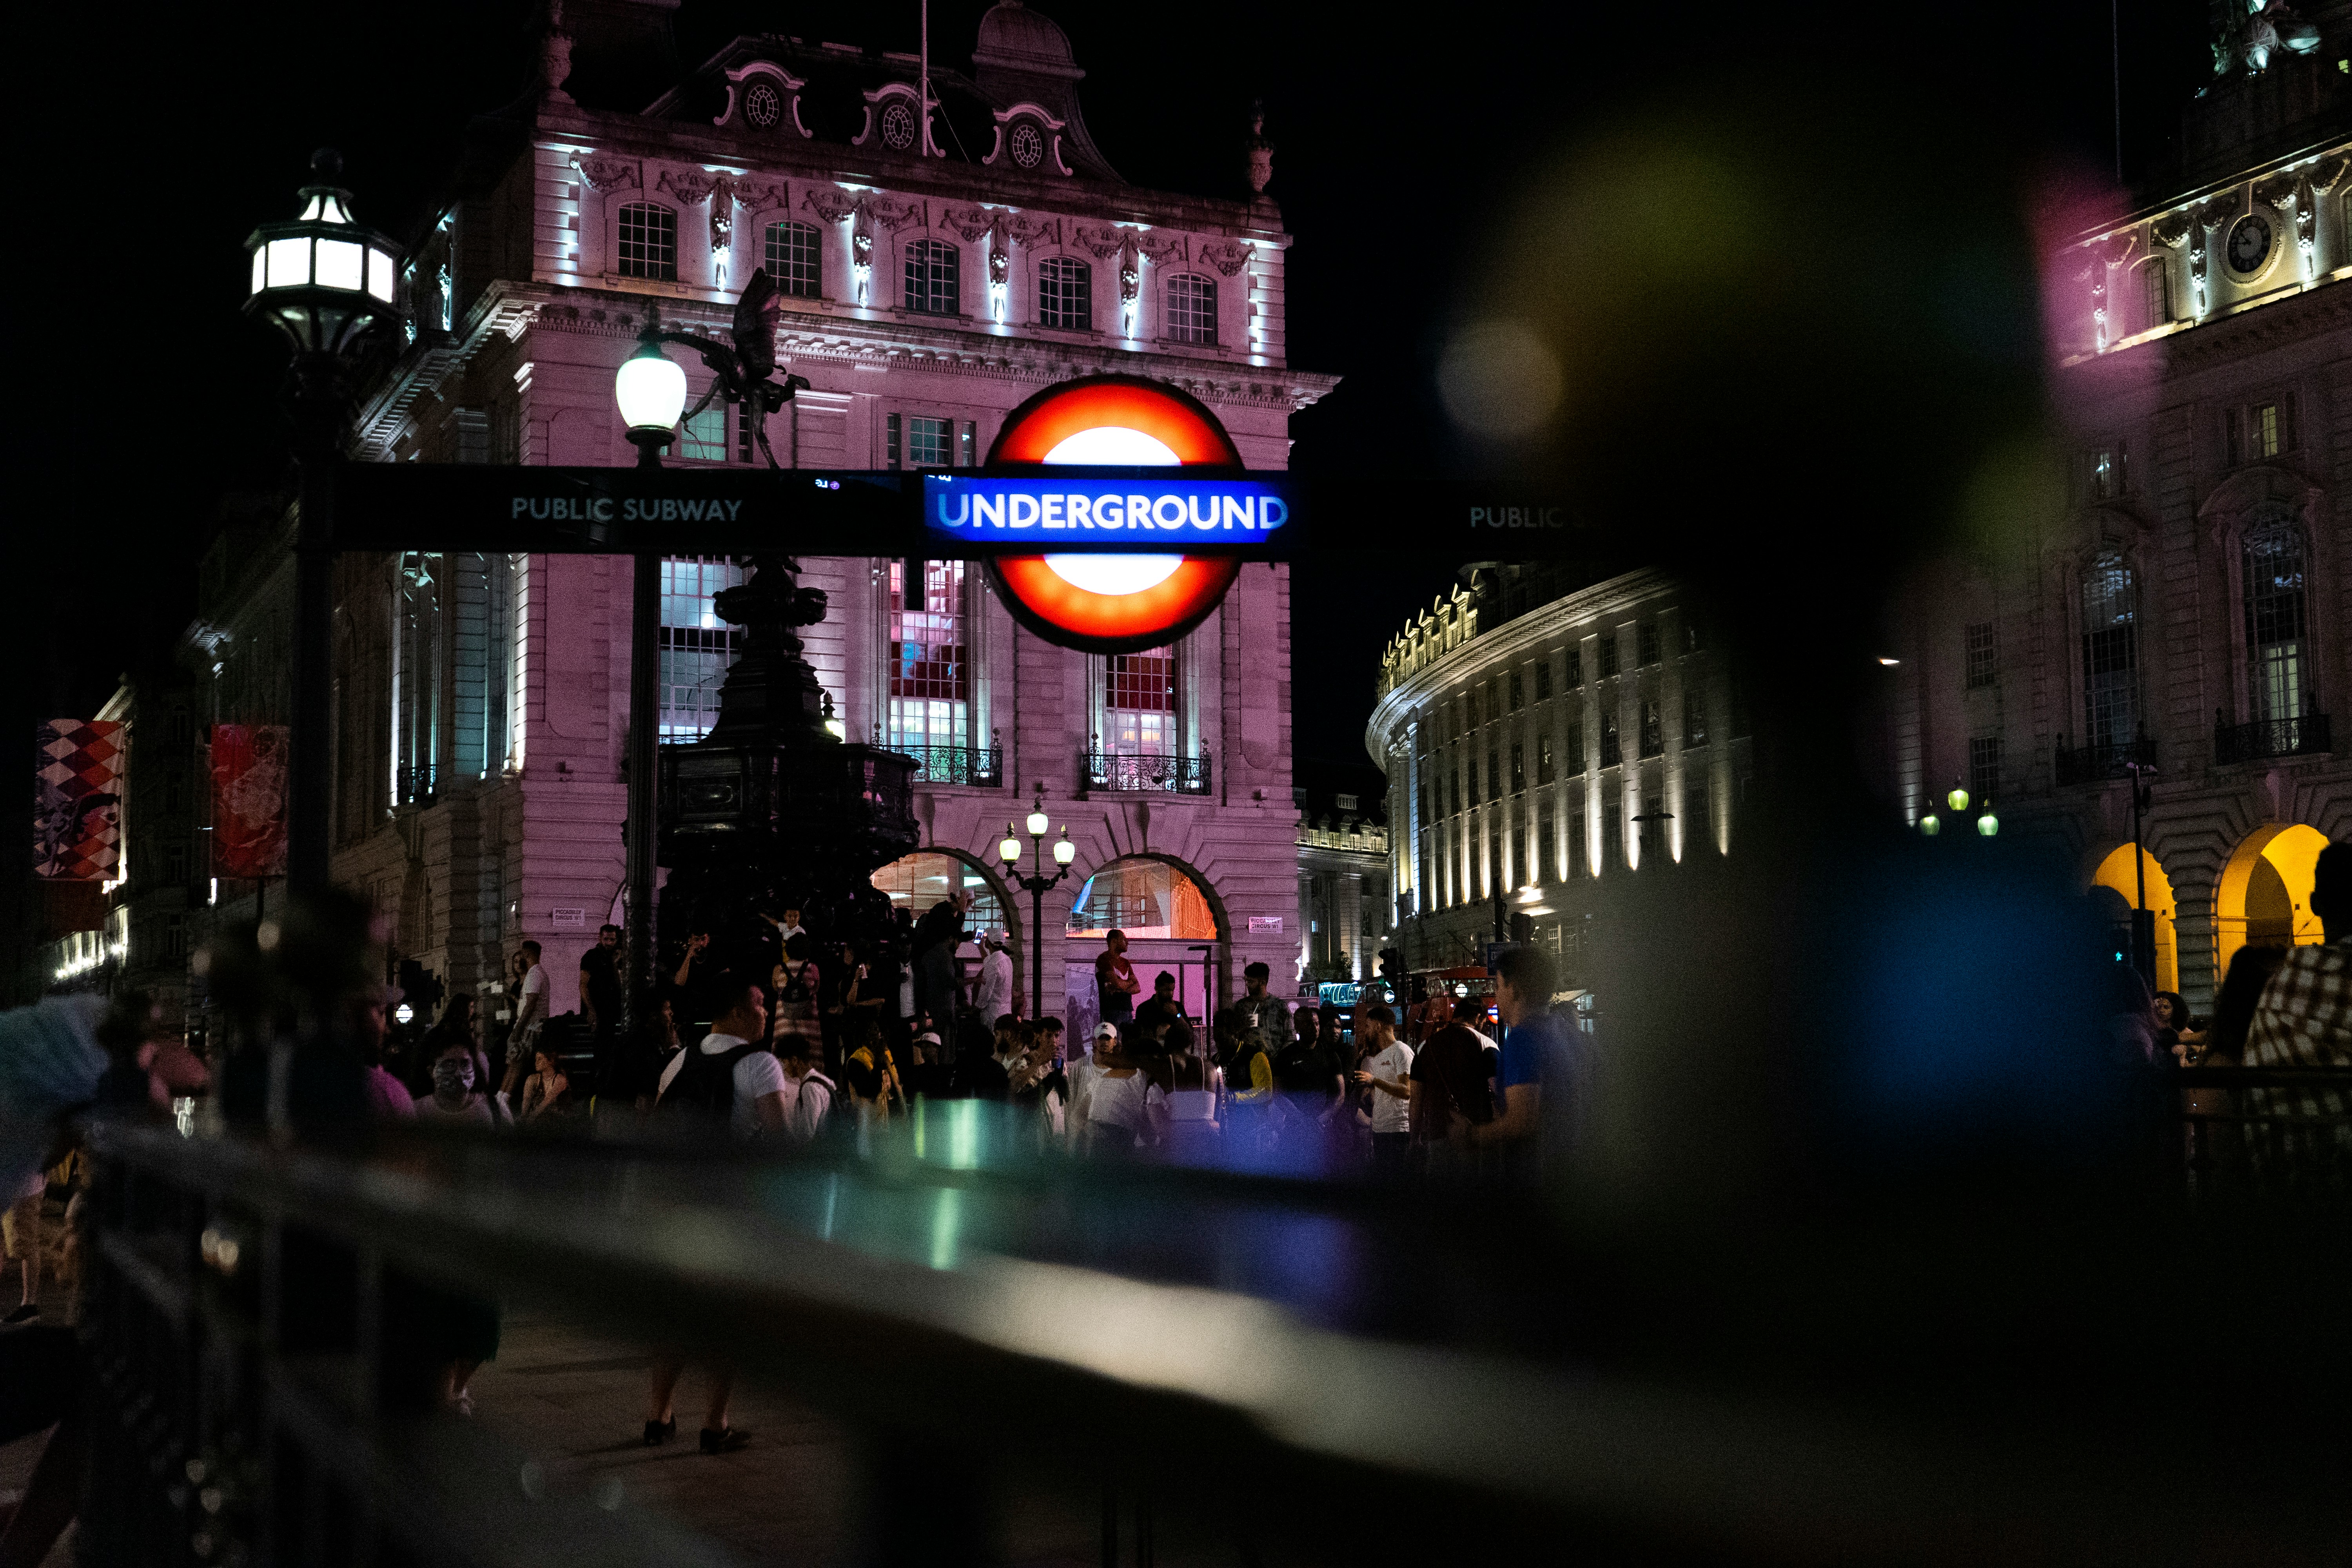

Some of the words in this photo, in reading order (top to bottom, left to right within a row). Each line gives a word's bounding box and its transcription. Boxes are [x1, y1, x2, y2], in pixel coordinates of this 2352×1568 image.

[511, 497, 614, 521] PUBLIC
[622, 498, 743, 522] SUBWAY
[938, 494, 1289, 530] UNDERGROUND
[1469, 506, 1564, 528] PUBLIC
